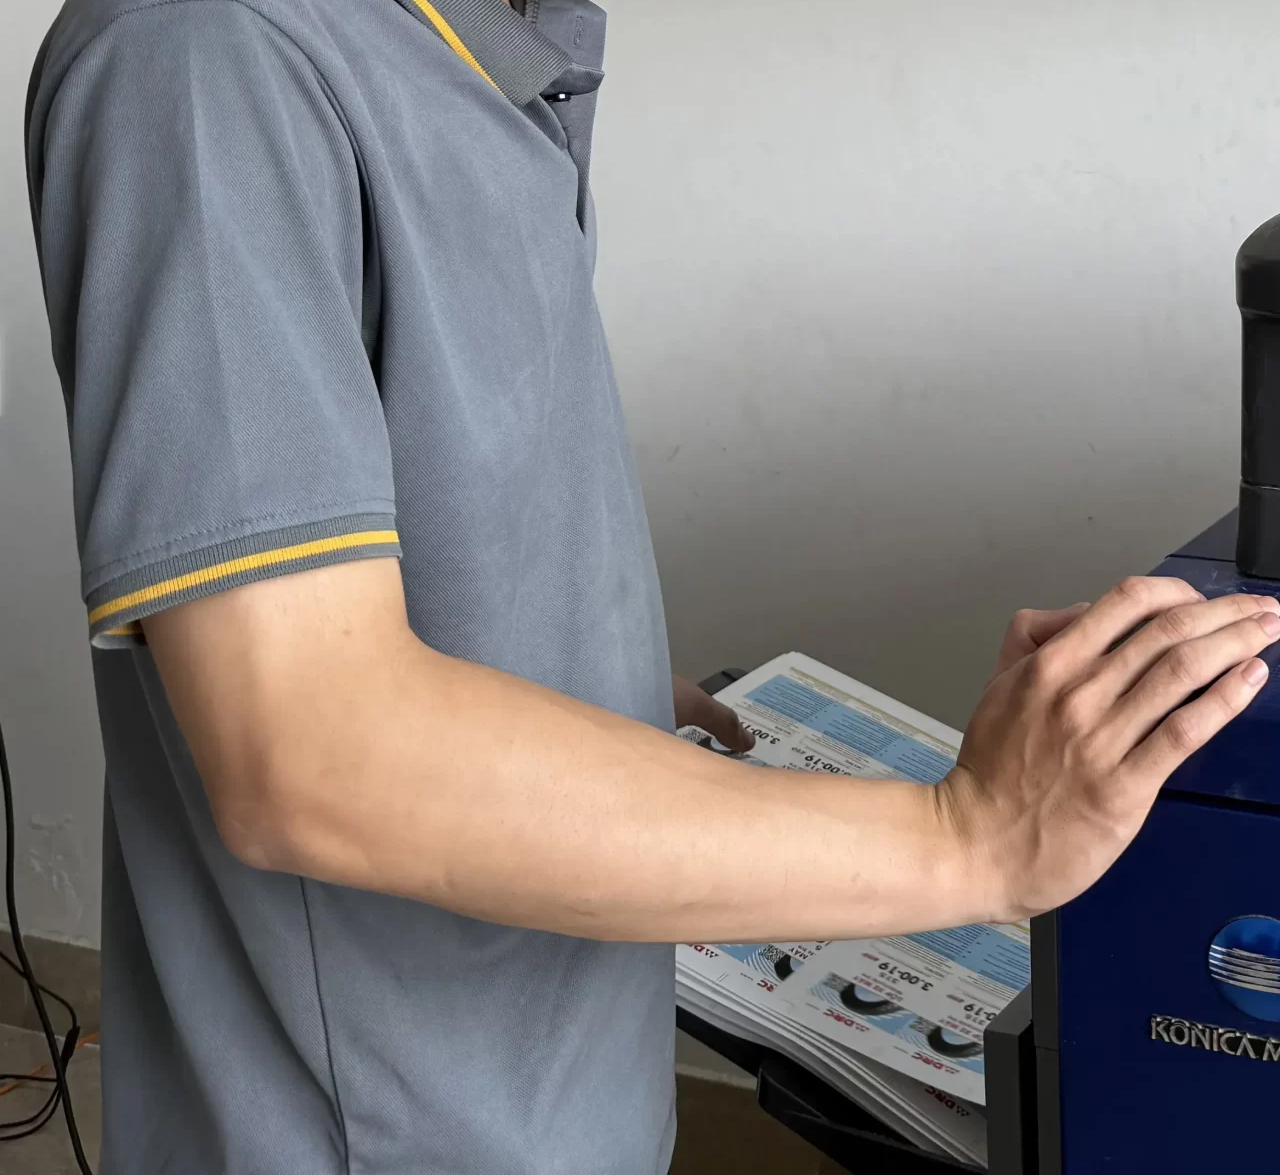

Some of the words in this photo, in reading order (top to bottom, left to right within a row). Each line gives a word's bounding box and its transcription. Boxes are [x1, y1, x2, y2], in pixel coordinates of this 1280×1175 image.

[877, 959, 934, 992] 3.00-19
[1150, 1014, 1259, 1059] KONICA
[924, 1085, 956, 1109] DRC
